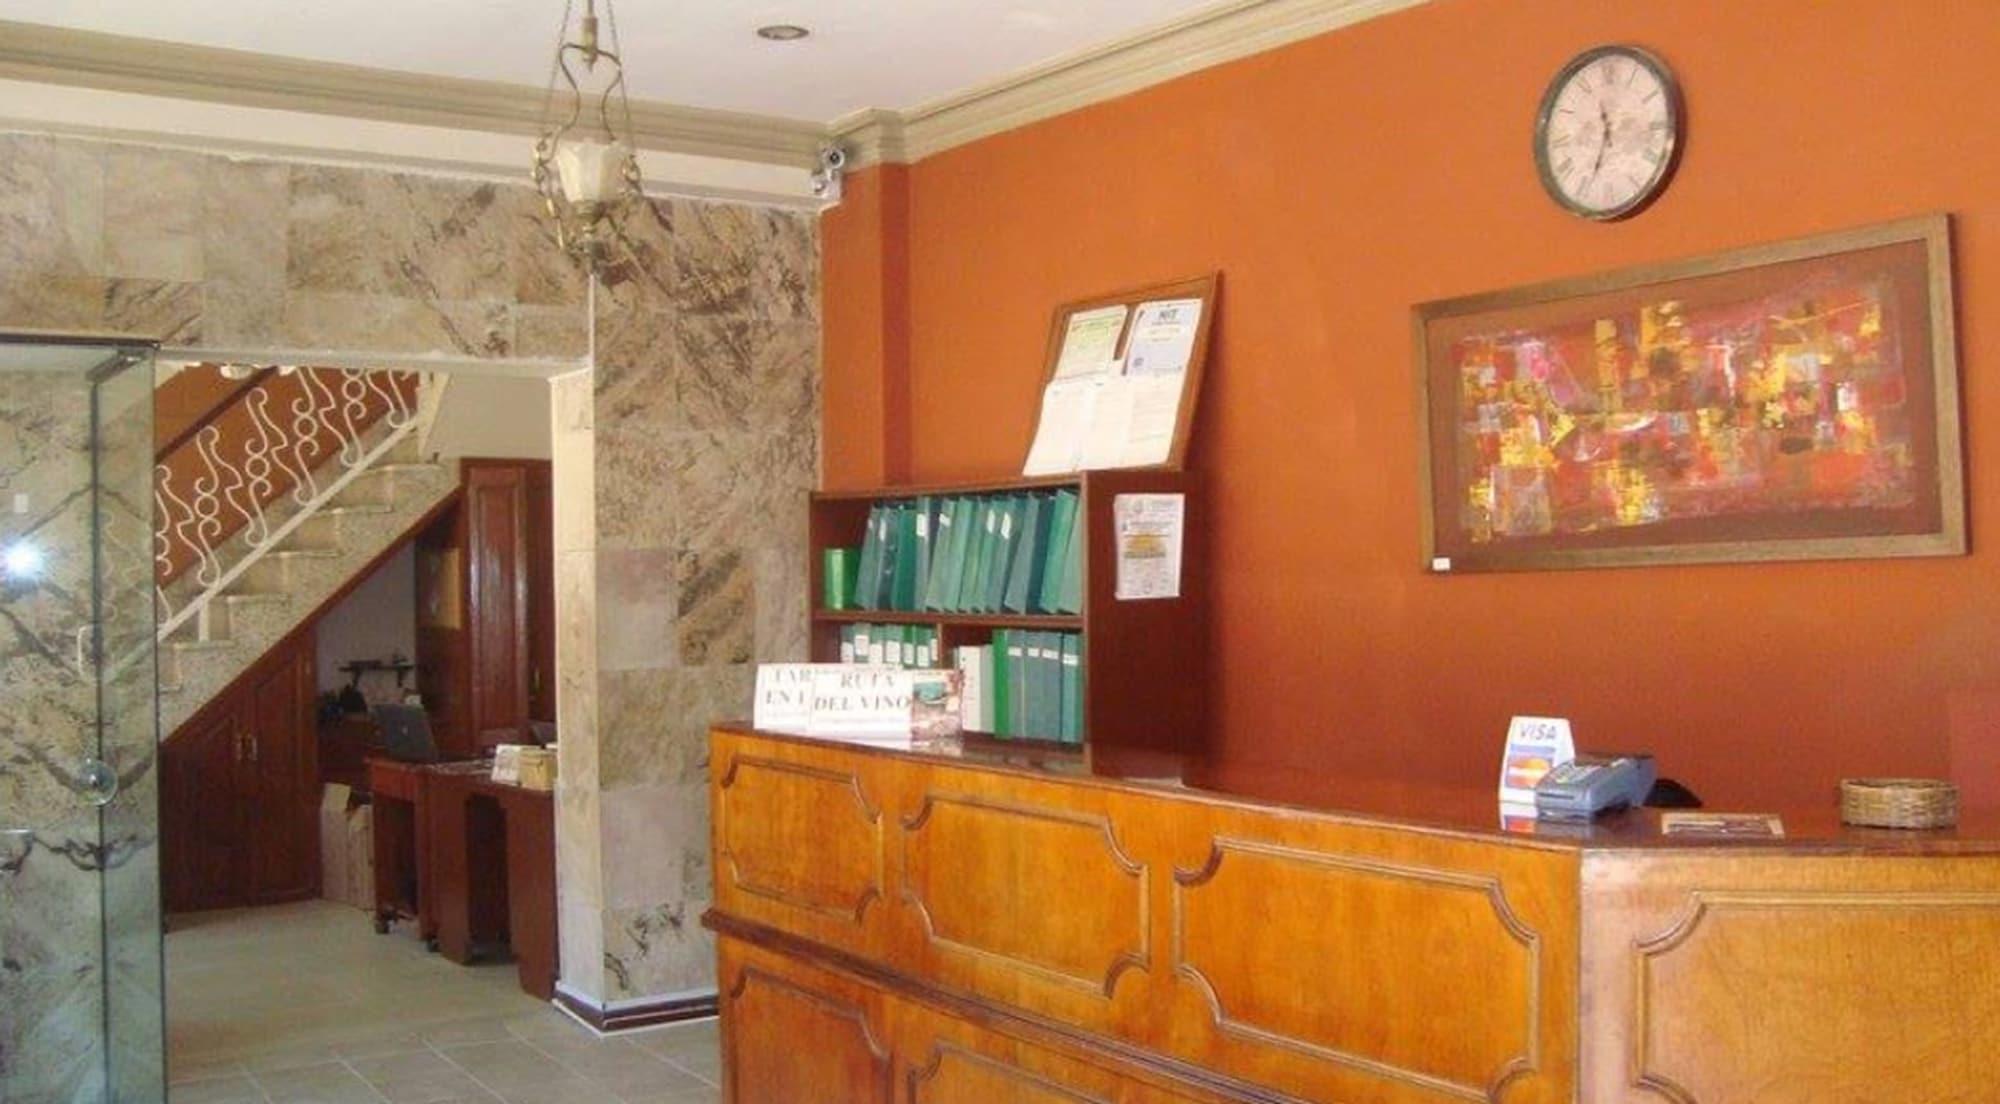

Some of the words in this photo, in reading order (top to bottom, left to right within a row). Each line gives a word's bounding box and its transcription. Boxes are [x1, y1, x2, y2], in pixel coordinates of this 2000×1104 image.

[814, 696, 853, 711] DEL
[858, 695, 911, 711] VINO
[1519, 723, 1557, 741] VISA
